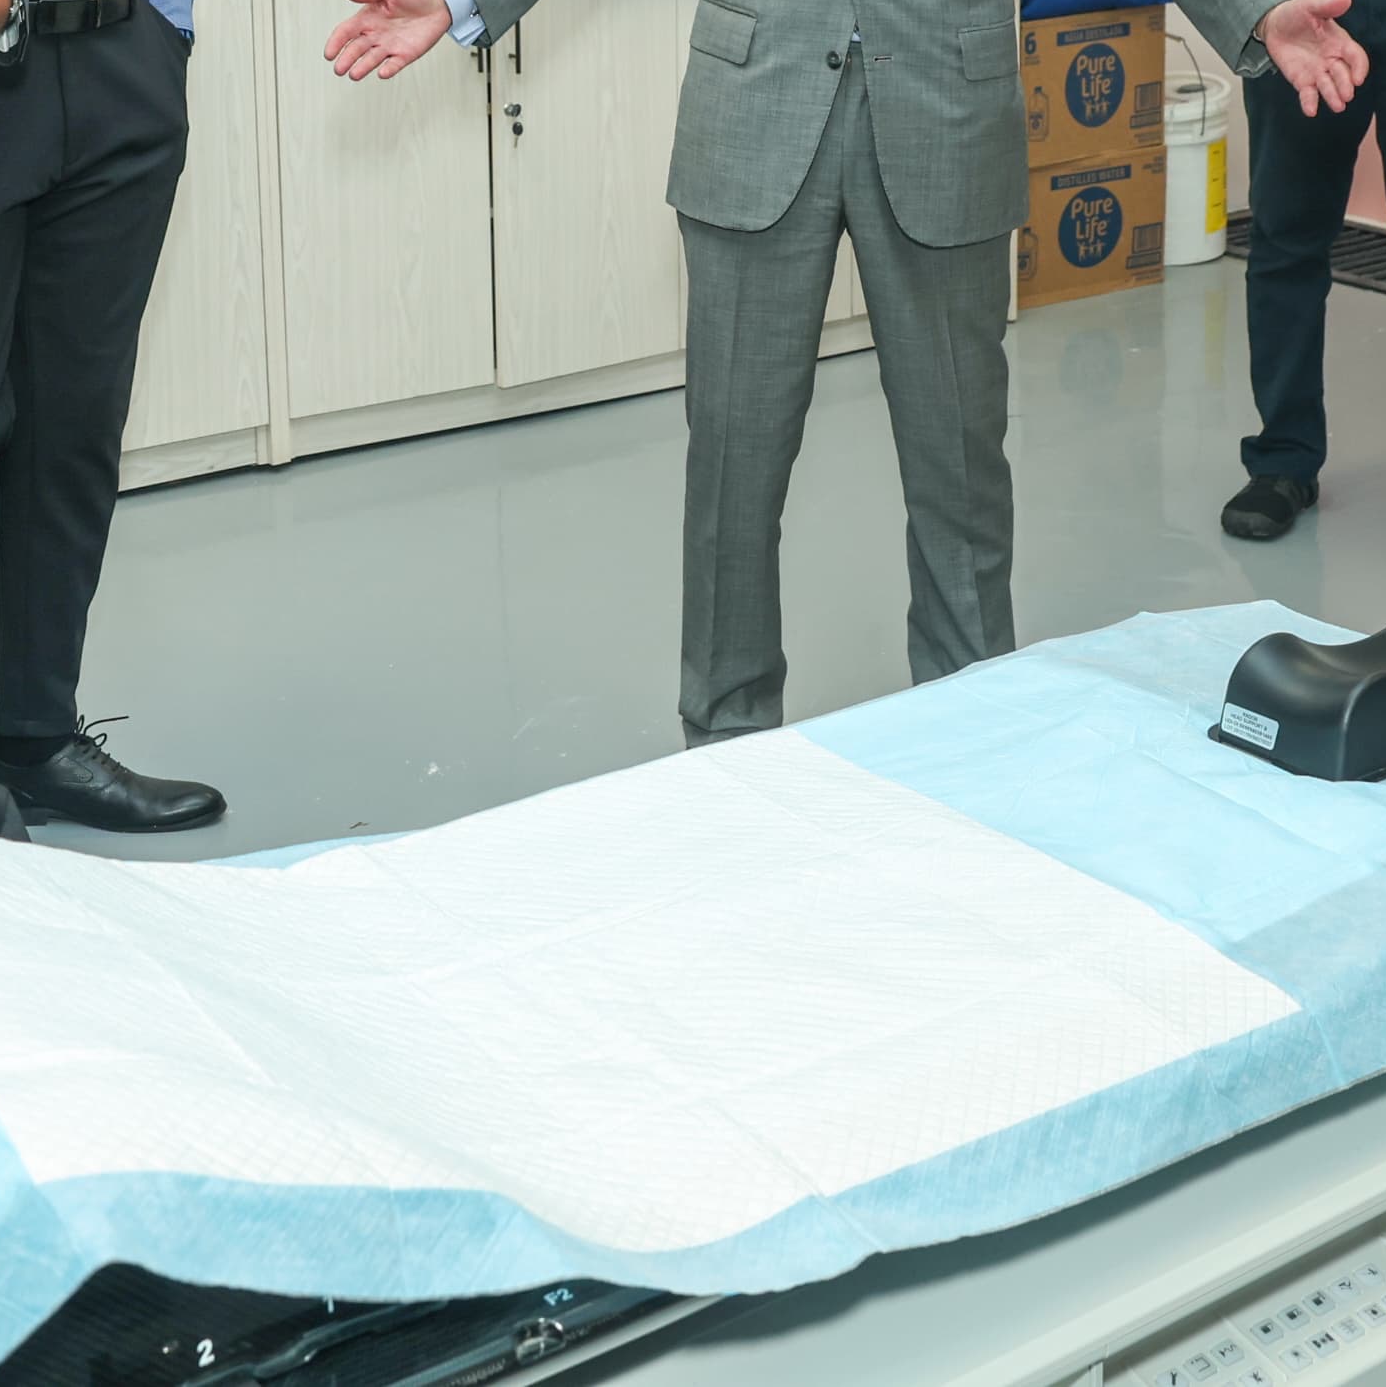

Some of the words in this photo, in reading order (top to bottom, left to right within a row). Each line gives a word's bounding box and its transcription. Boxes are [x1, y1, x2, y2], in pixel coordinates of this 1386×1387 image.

[1024, 31, 1037, 55] 6
[1076, 54, 1116, 76] Pure
[1081, 74, 1111, 101] Life
[1071, 197, 1114, 220] Pure
[1076, 216, 1108, 243] Life
[543, 1287, 575, 1307] F2
[195, 1337, 216, 1368] 2
